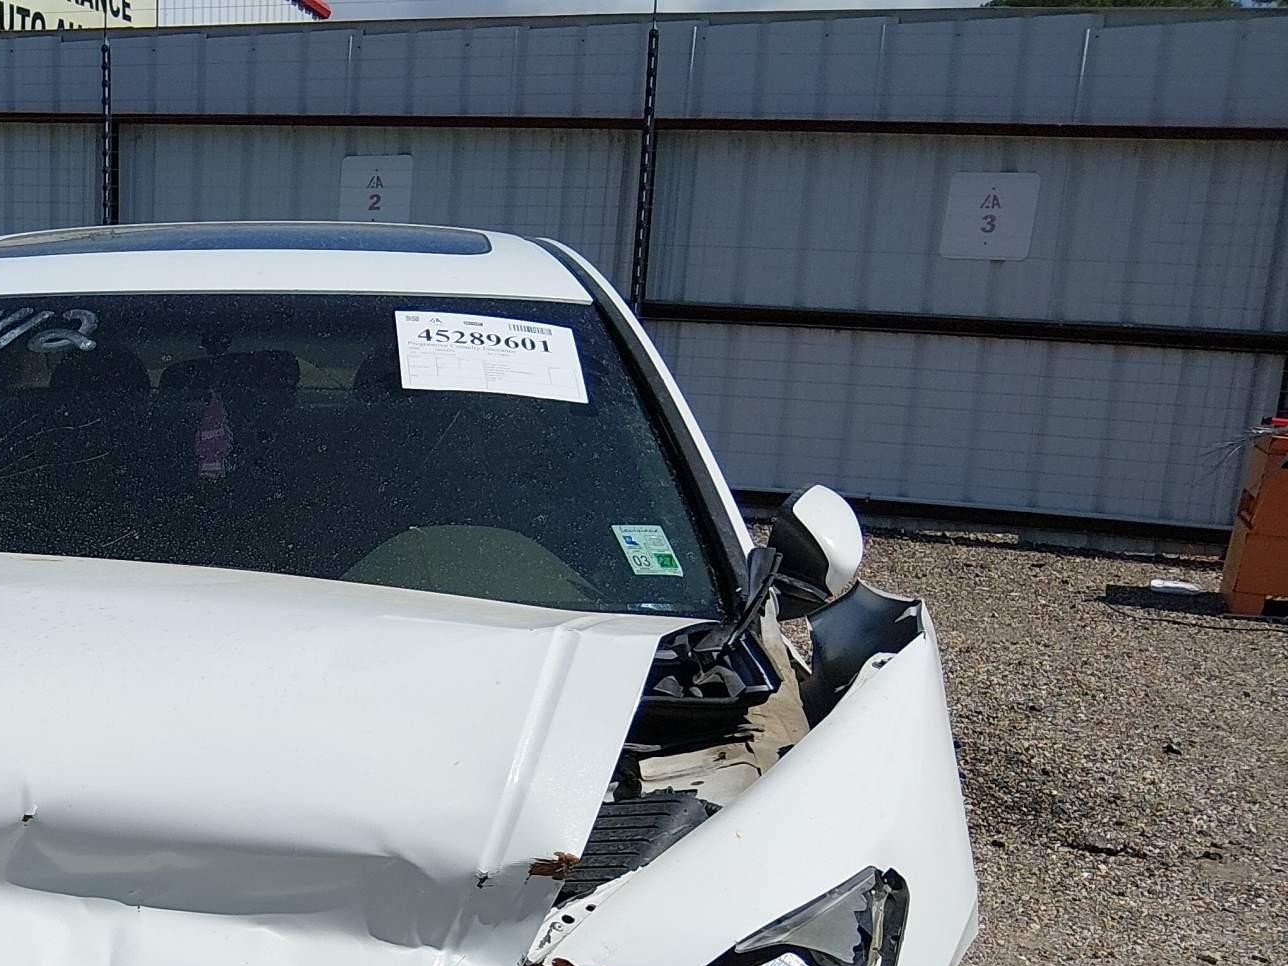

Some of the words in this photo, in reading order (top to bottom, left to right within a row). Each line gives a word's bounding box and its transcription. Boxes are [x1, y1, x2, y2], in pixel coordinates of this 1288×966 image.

[368, 194, 381, 211] 2
[980, 214, 997, 233] 3
[417, 328, 553, 353] 45289601
[632, 554, 651, 568] 03
[656, 554, 675, 568] 27
